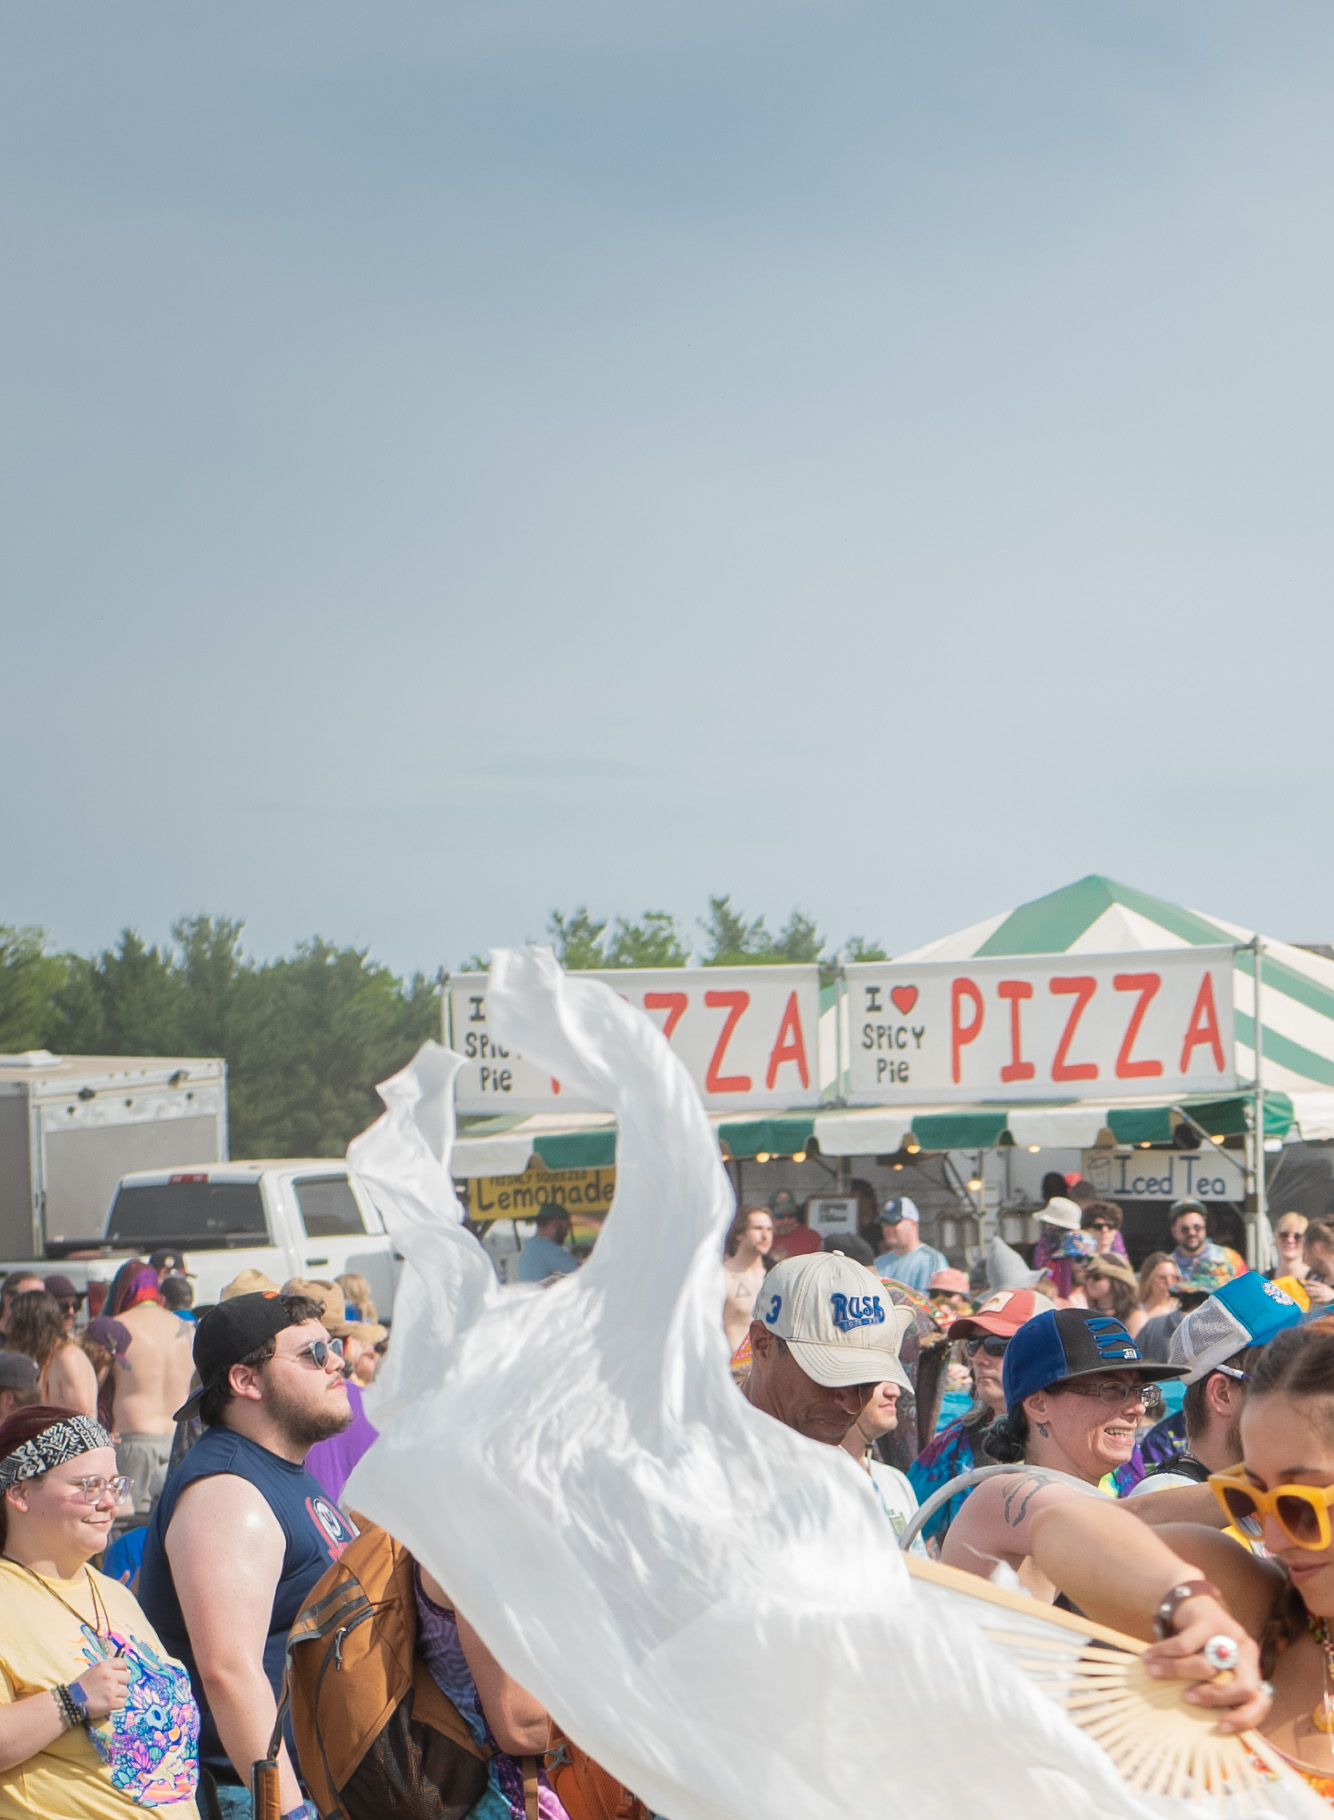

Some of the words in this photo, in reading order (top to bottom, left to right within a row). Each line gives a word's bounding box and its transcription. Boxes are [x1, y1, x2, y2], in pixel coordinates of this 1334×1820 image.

[865, 986, 883, 1012] I
[951, 970, 1226, 1085] PIZZA
[480, 1066, 512, 1092] Pie
[876, 1058, 910, 1083] Pie
[1114, 1154, 1173, 1195] Iced
[1179, 1155, 1226, 1195] Tea
[765, 1294, 782, 1325] 3
